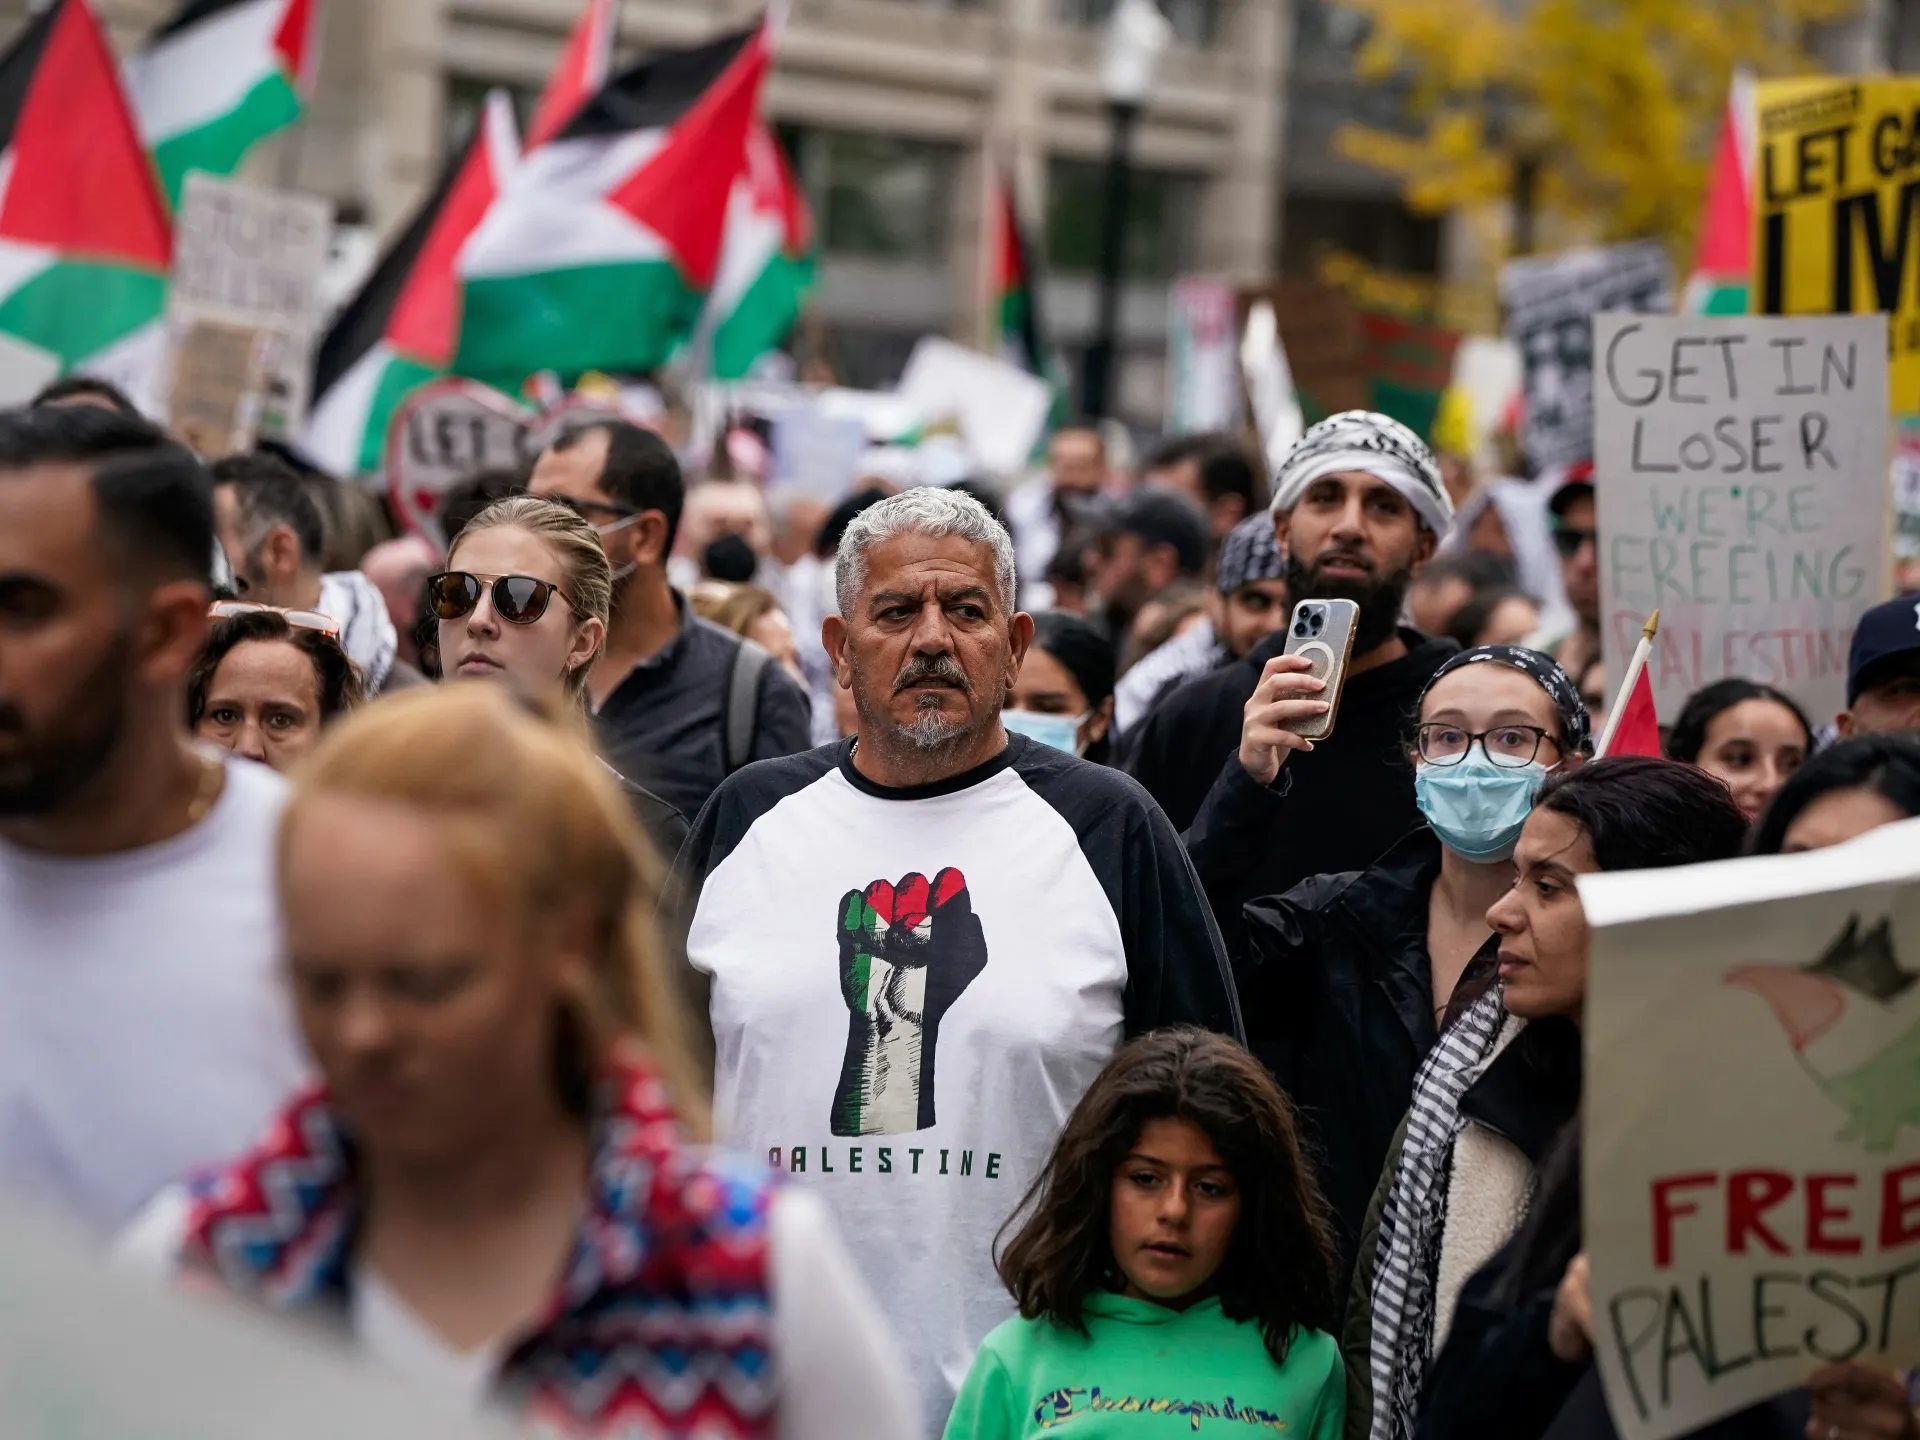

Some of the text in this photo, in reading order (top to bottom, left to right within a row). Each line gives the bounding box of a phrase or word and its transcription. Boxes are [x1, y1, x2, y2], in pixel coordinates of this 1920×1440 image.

[1762, 125, 1855, 198] LET
[1606, 323, 1857, 406] GET IN
[1631, 412, 1838, 473] LOSER
[1611, 535, 1865, 605] FREEING
[768, 1146, 1001, 1179] PALESTINE
[1650, 1162, 1920, 1269] FREE
[1034, 1386, 1288, 1432] Champion
